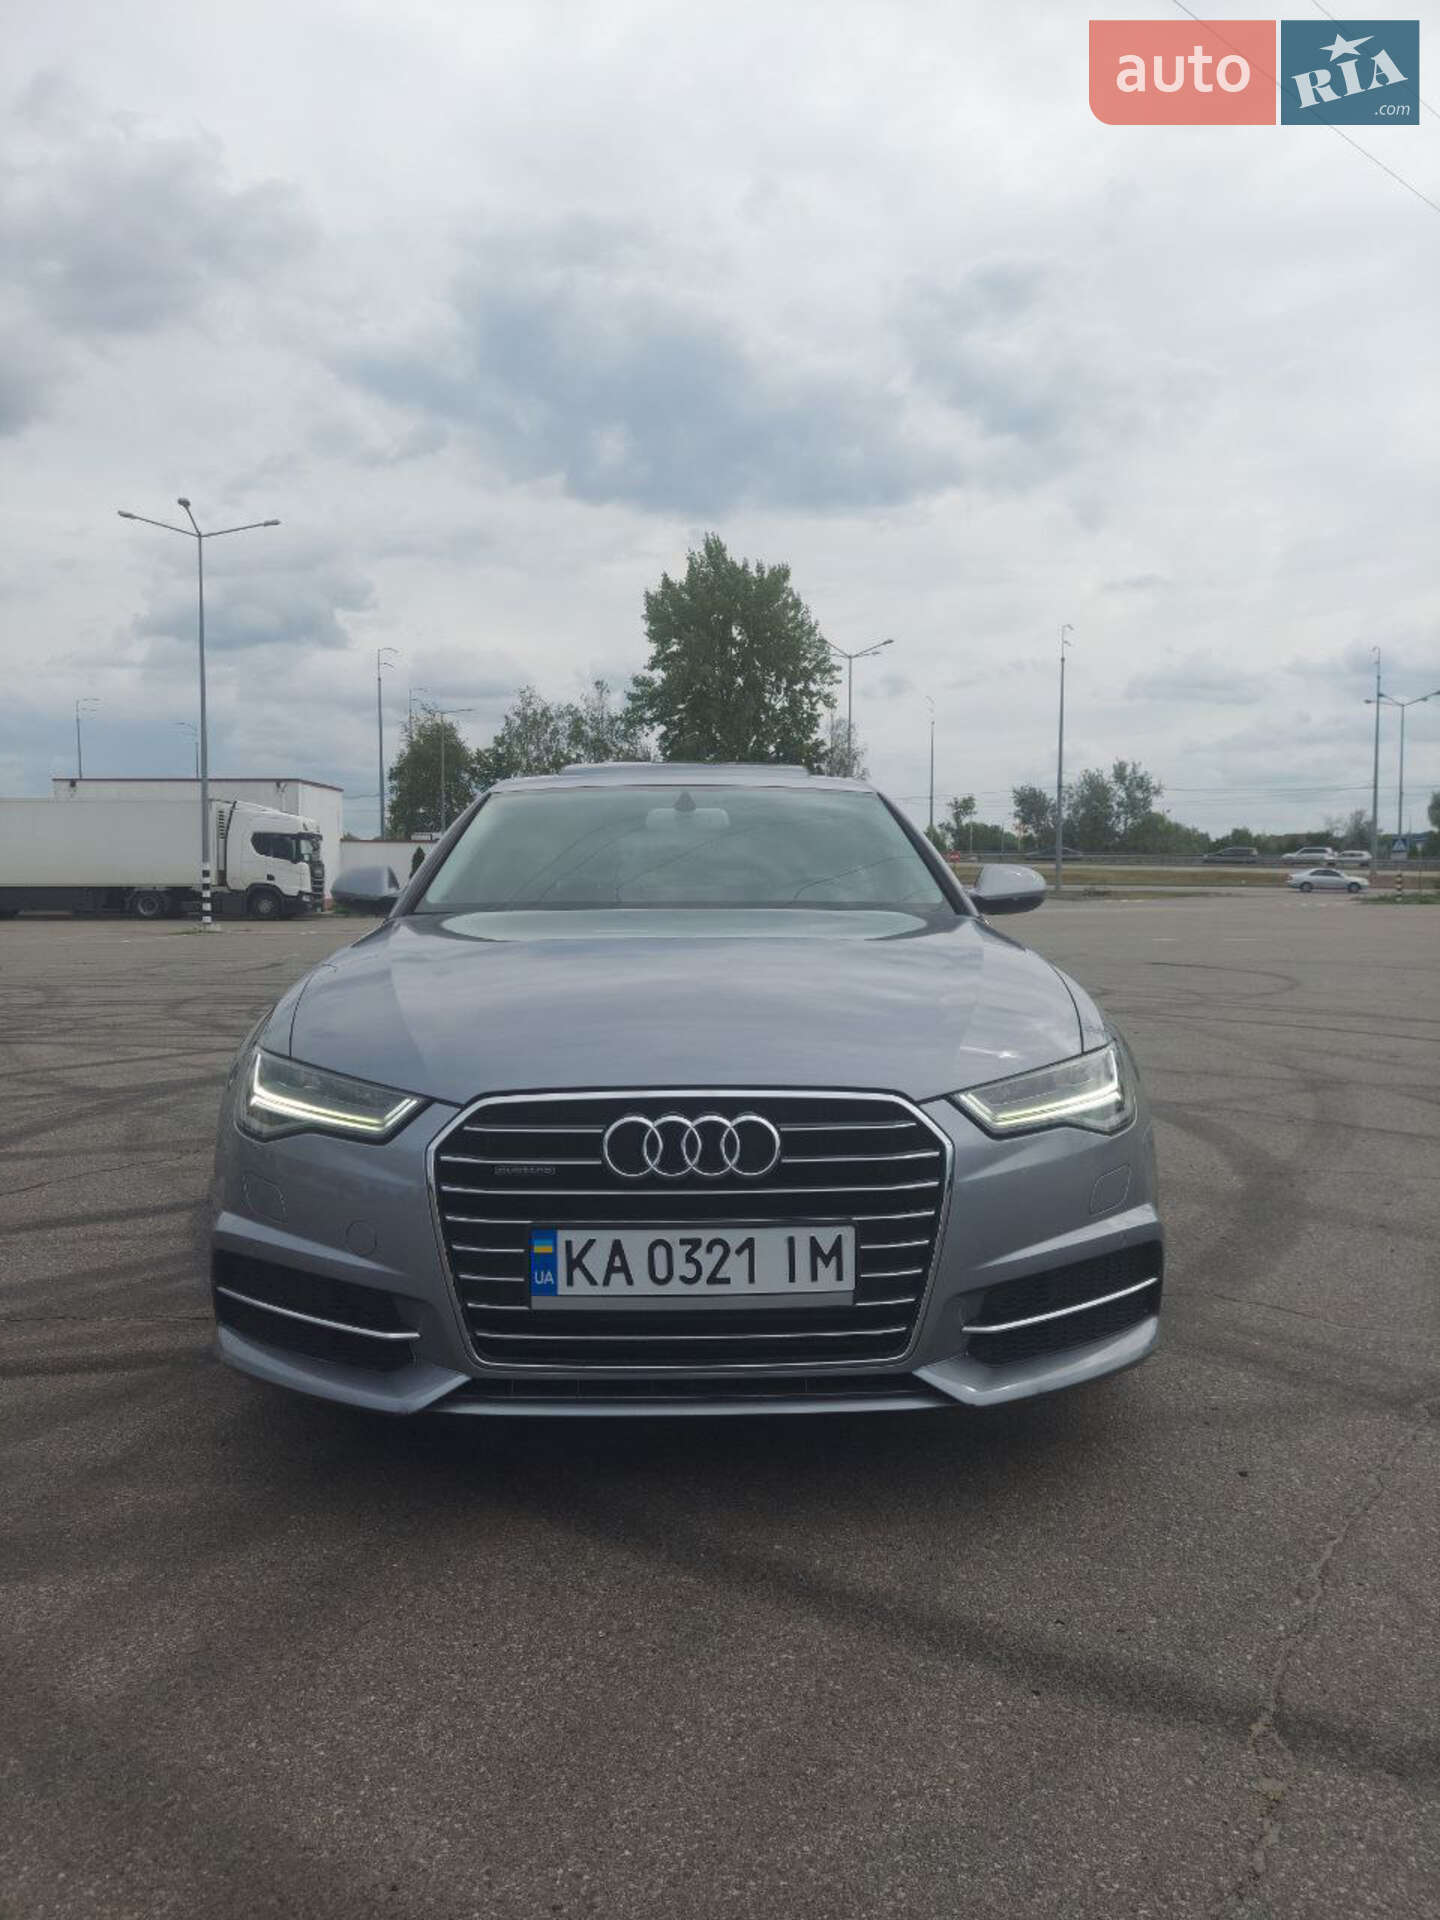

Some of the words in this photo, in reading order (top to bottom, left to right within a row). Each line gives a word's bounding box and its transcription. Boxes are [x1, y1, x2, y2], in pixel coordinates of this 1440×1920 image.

[565, 1238, 634, 1287] KA
[647, 1237, 756, 1285] 0321
[788, 1234, 844, 1284] IM
[534, 1271, 555, 1285] UA
